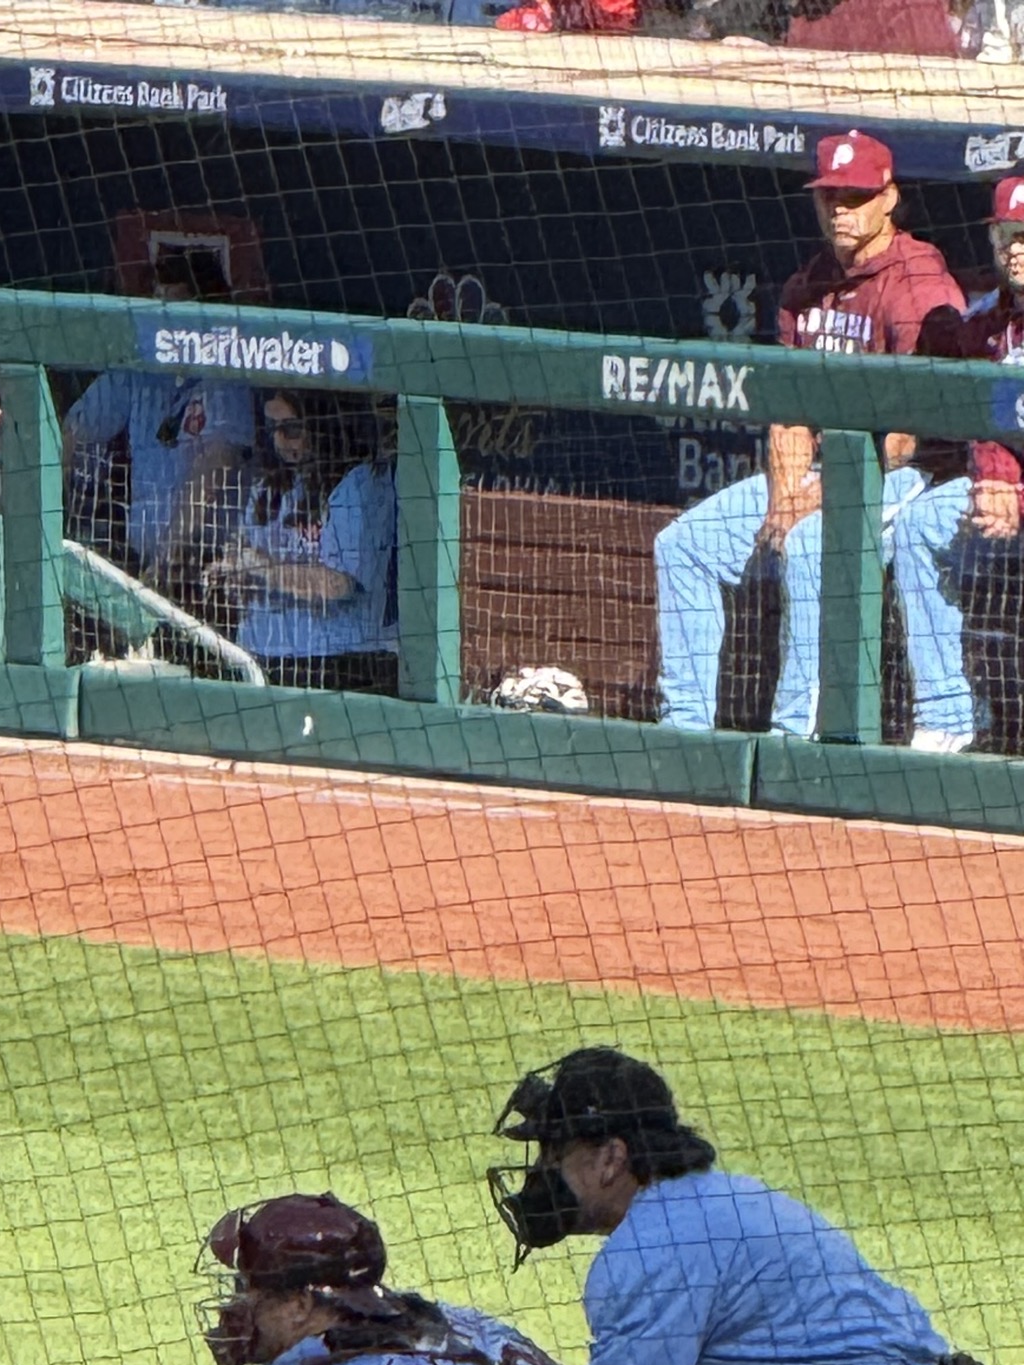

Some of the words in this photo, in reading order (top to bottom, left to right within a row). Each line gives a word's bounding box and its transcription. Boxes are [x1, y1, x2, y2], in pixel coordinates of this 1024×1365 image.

[186, 83, 227, 112] Park
[631, 115, 709, 147] Citizens
[710, 121, 759, 152] Bank
[762, 124, 805, 153] Park
[155, 326, 324, 375] smartwater
[602, 354, 754, 411] RE/MAX
[679, 437, 764, 491] Ban
